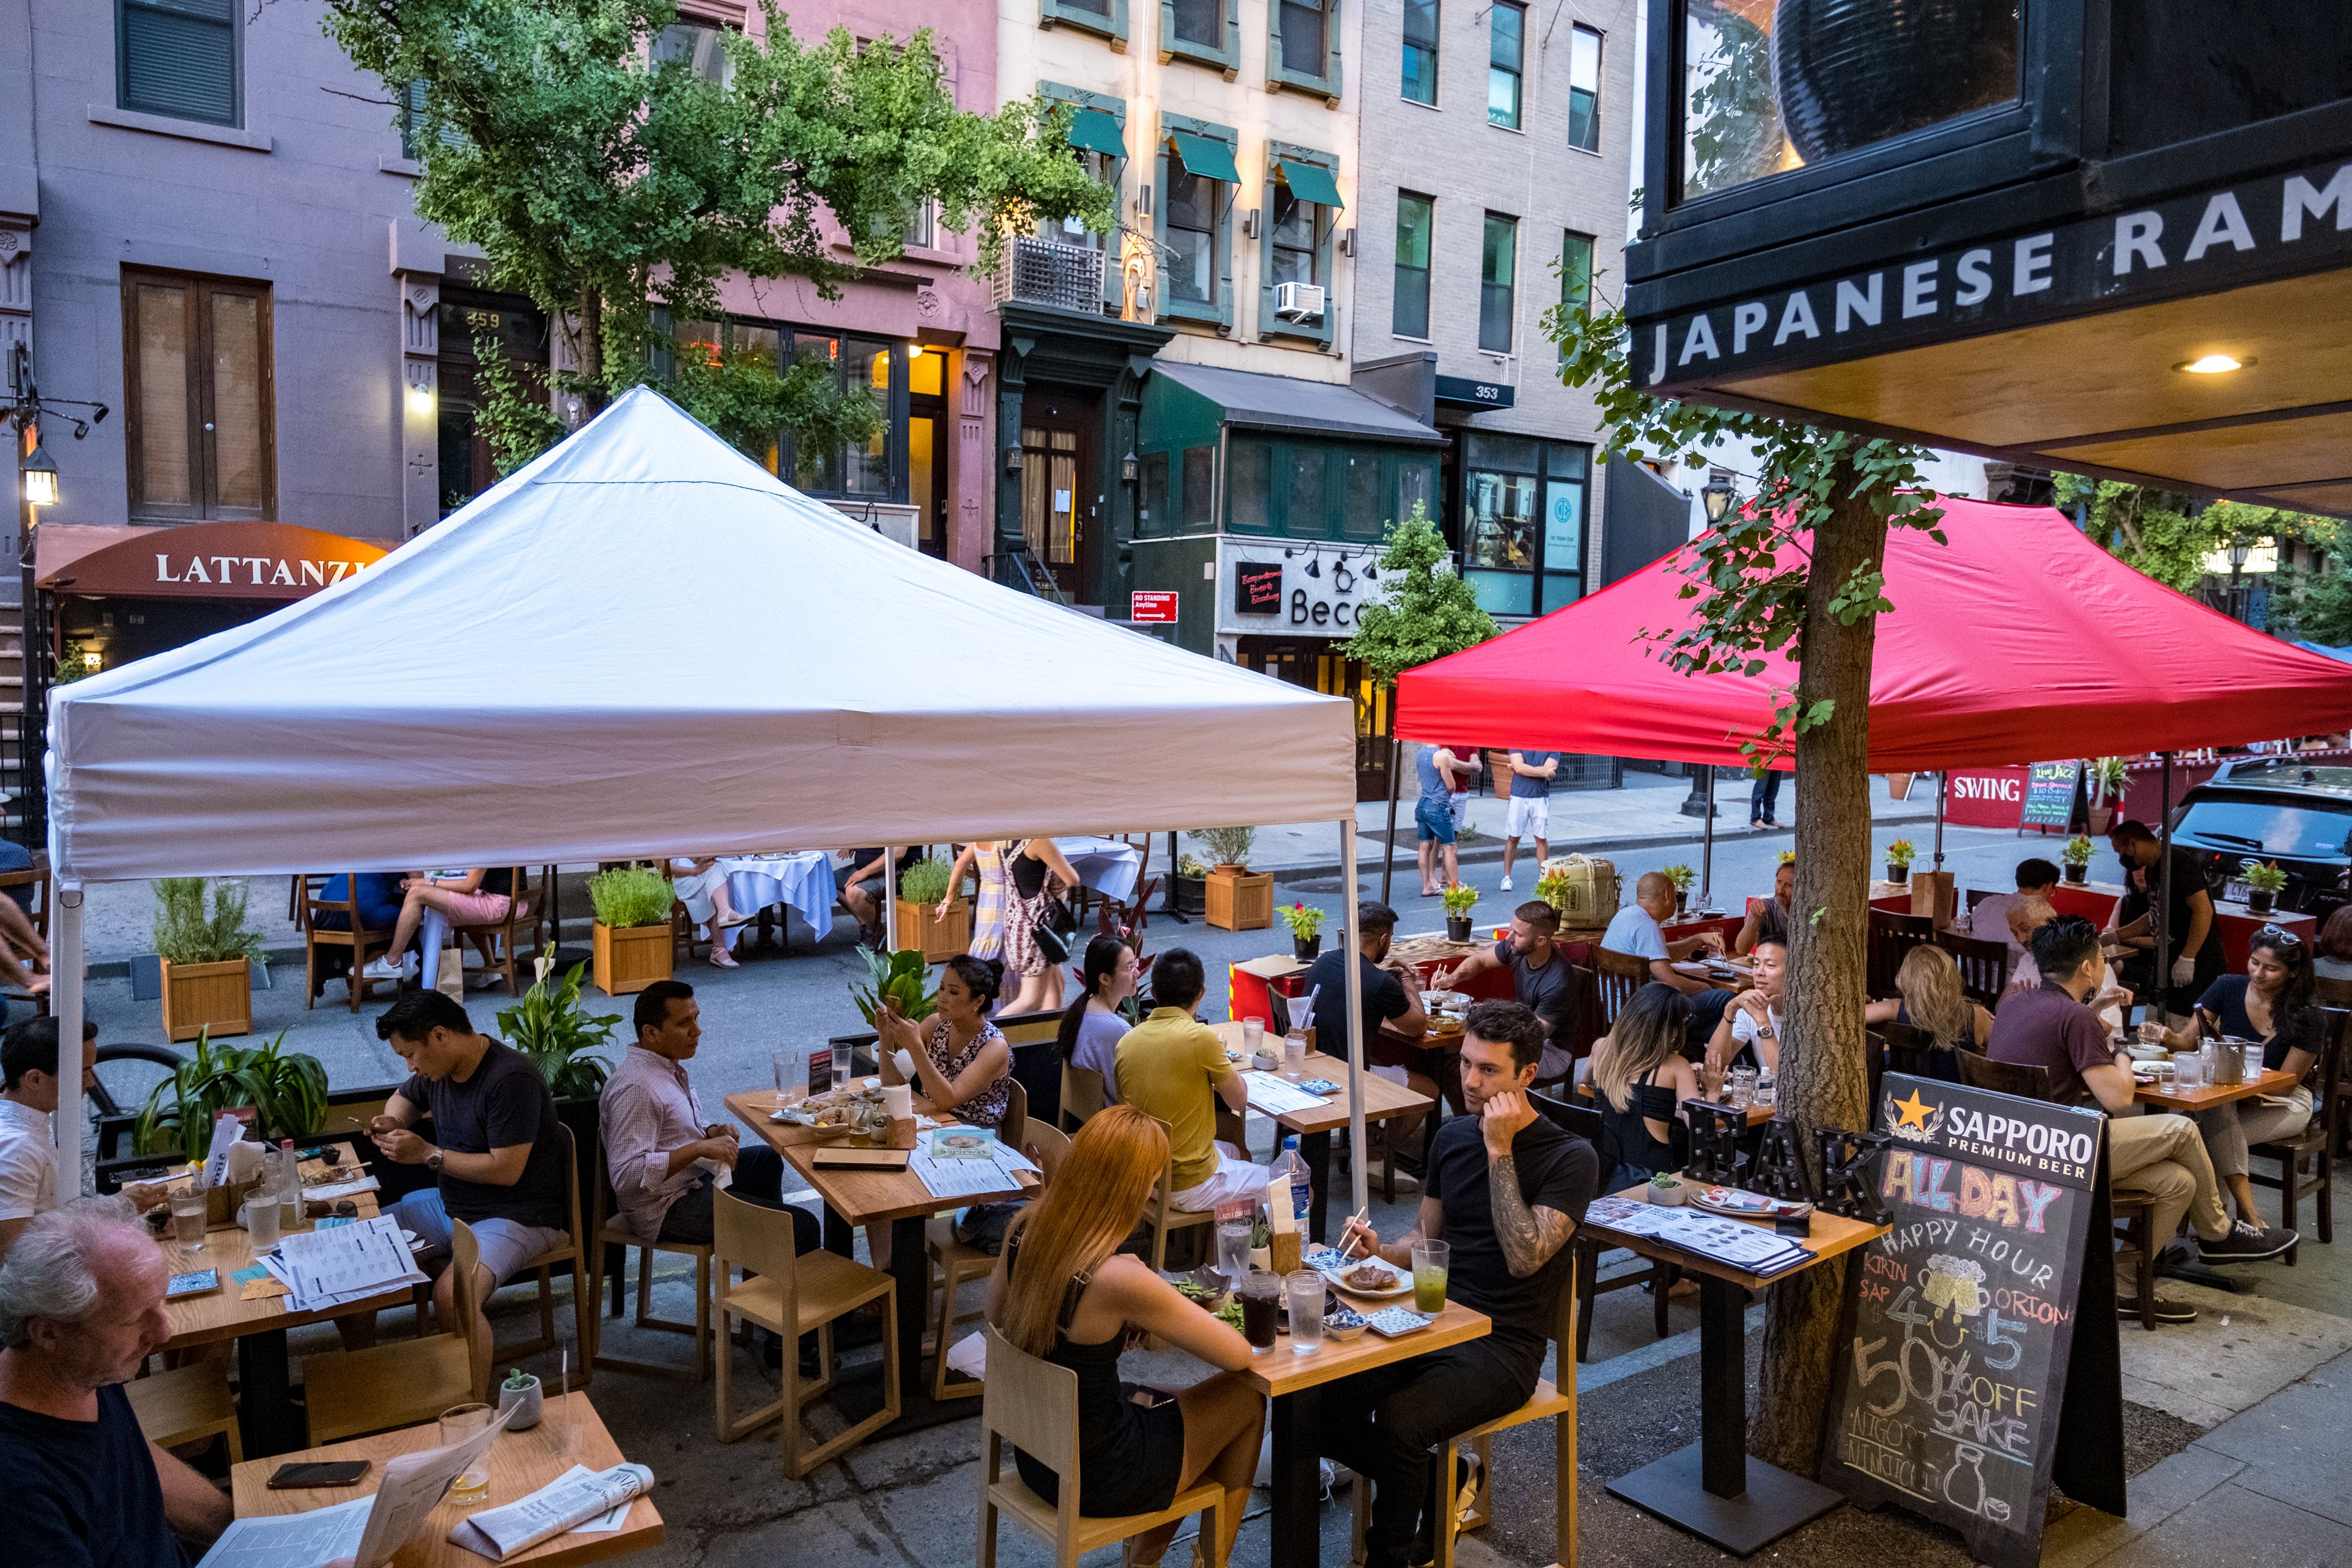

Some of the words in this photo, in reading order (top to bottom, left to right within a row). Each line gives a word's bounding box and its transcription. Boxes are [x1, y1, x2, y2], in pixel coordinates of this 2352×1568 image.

[1649, 233, 2053, 386] JAPANESE
[1475, 386, 1498, 400] 353
[1291, 589, 1390, 626] Becc
[1954, 777, 2020, 802] SWING
[1947, 1107, 2093, 1165] SAPPORO
[1948, 1136, 2032, 1166] PREMIUM
[2039, 1158, 2086, 1179] BEER
[1222, 1211, 1244, 1219] FOLLOW
[1883, 1150, 1955, 1213] ALL
[1959, 1165, 2063, 1234] DAY
[1863, 1251, 1907, 1283] KIRIN
[1882, 1219, 1958, 1256] HAPPY
[1969, 1226, 2054, 1289] HOUR
[1859, 1279, 1890, 1303] SAP
[1994, 1288, 2070, 1326] ORION
[1853, 1335, 1974, 1417] 50%
[1973, 1376, 2037, 1417] OFF
[1933, 1391, 2031, 1457] SAKE
